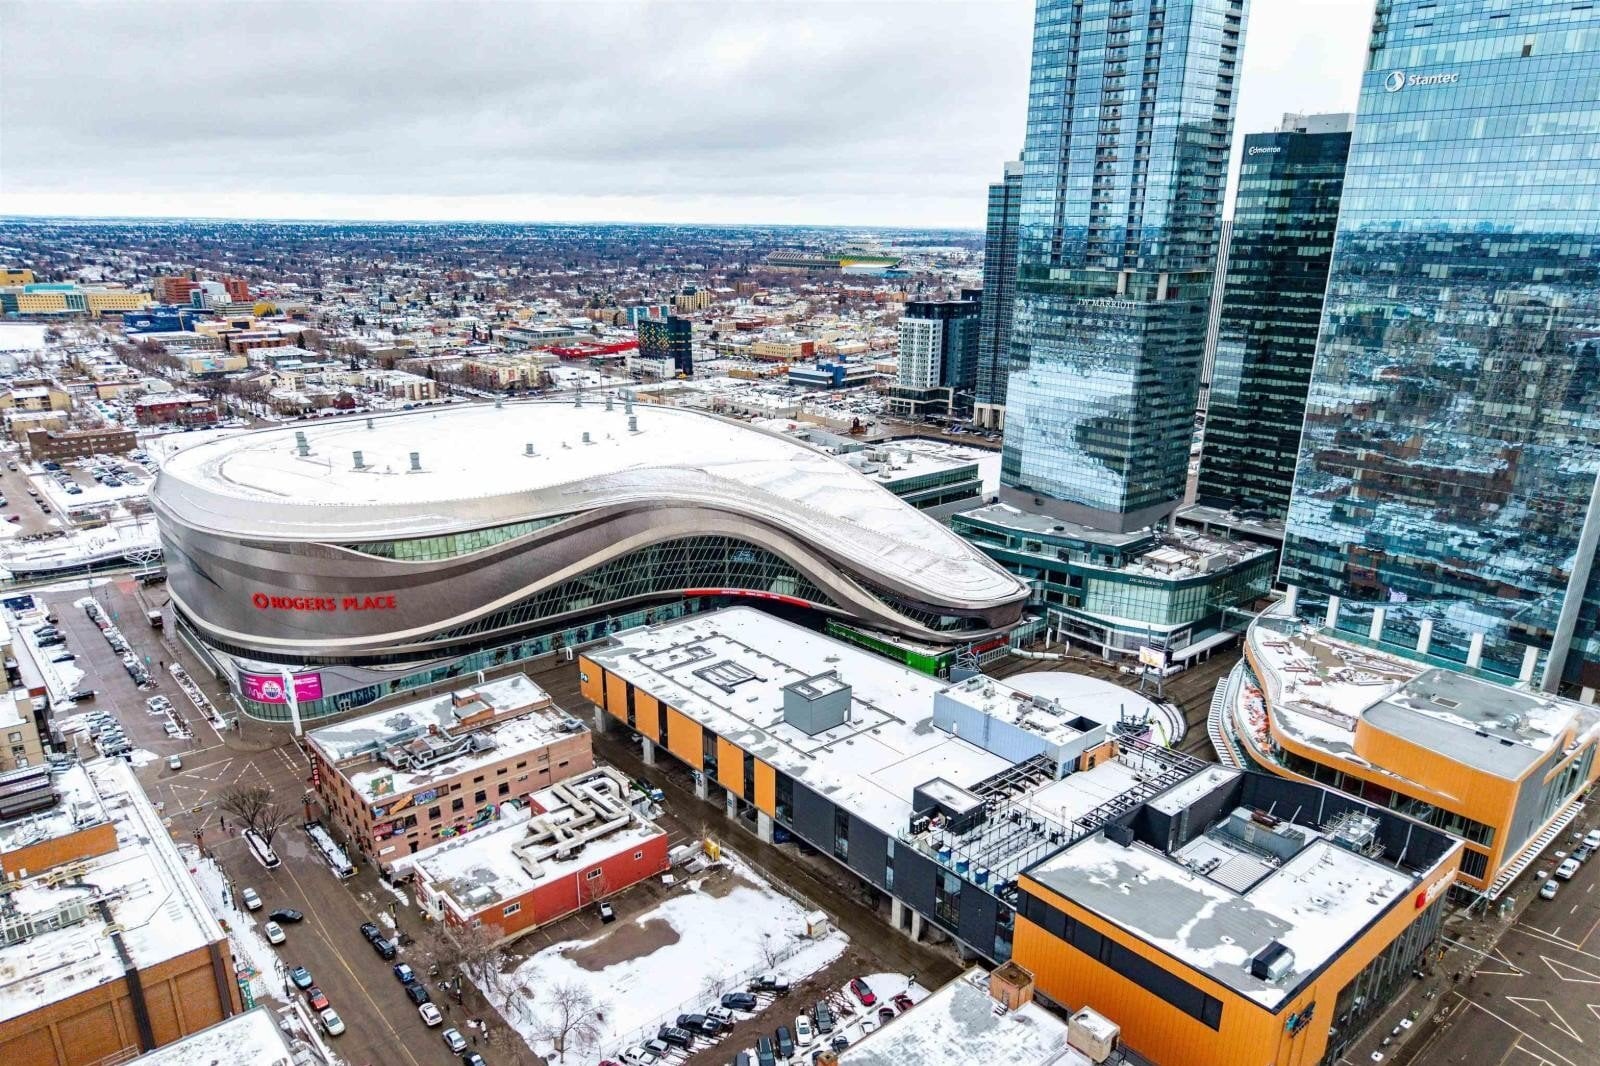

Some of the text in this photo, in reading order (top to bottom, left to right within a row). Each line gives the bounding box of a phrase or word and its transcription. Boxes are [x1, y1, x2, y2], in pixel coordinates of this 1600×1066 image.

[1408, 73, 1459, 86] Stantec
[1248, 146, 1281, 156] Edmonton
[1092, 299, 1137, 309] MARRIOTT
[270, 594, 397, 611] ROGERS PLACE
